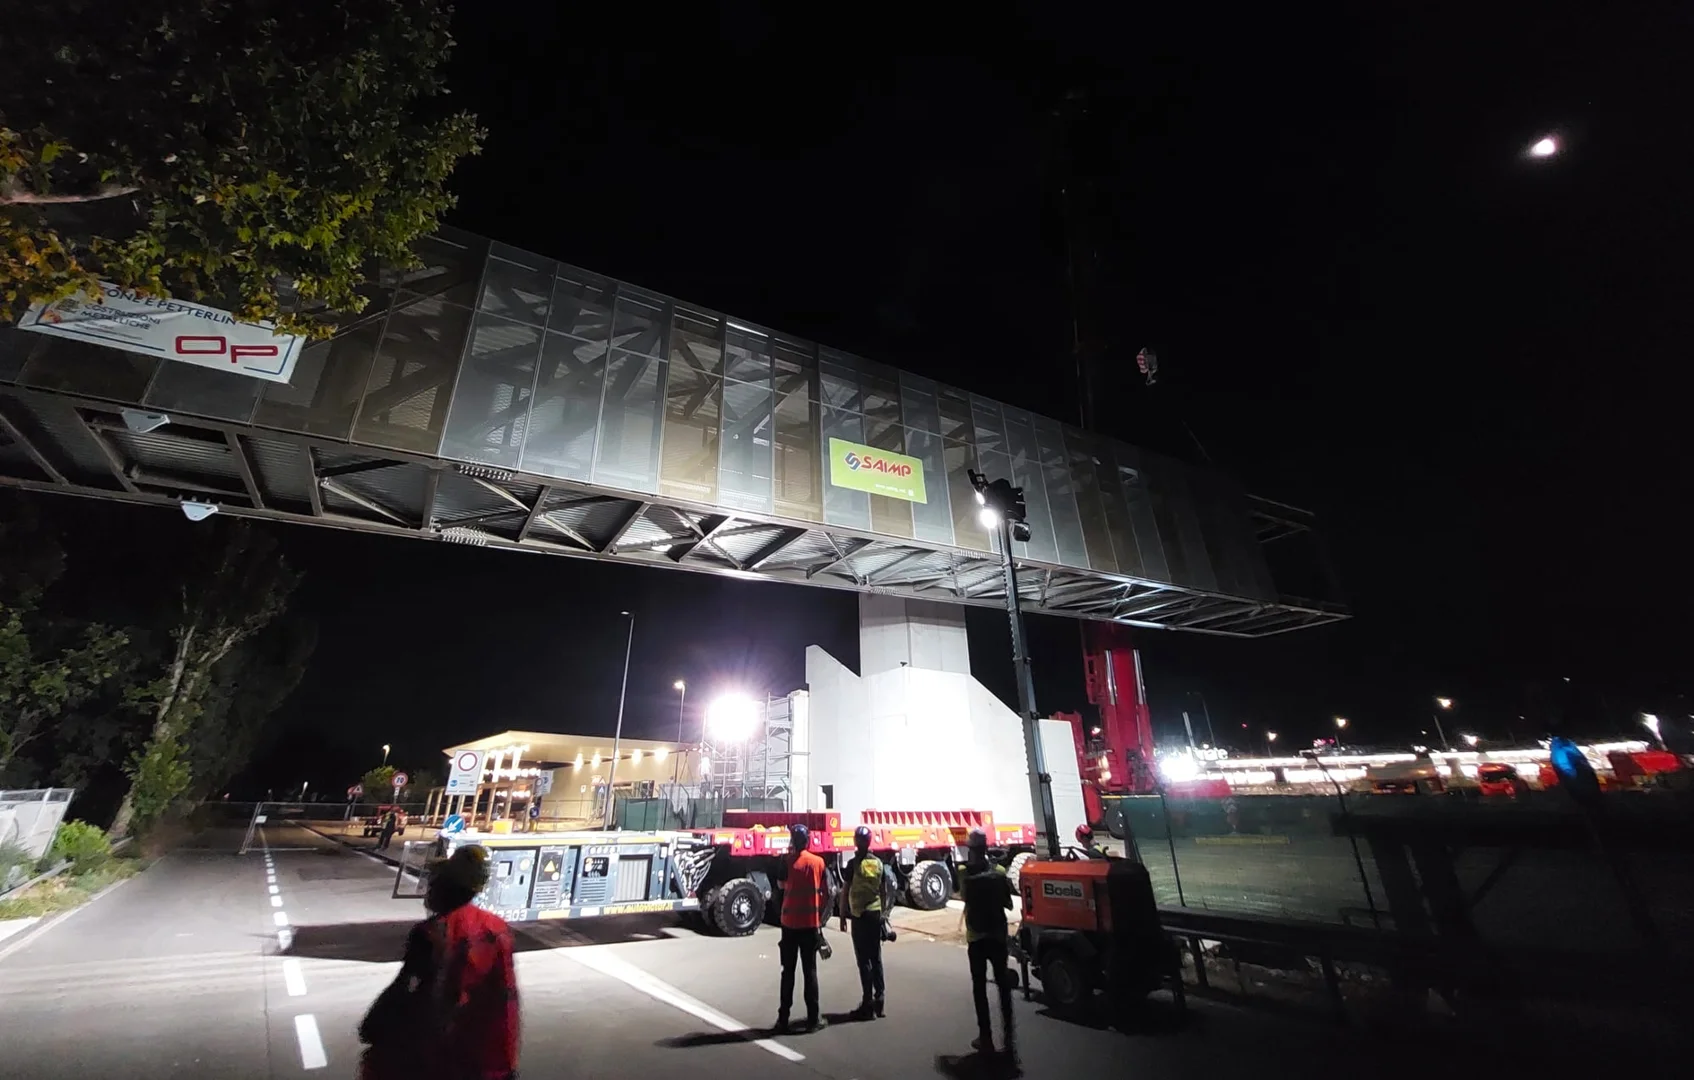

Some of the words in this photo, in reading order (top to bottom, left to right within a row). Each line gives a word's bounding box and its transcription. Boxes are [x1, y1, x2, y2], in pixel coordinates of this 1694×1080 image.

[144, 296, 154, 307] E
[861, 456, 911, 477] SAIMP
[1044, 883, 1083, 897] Boels
